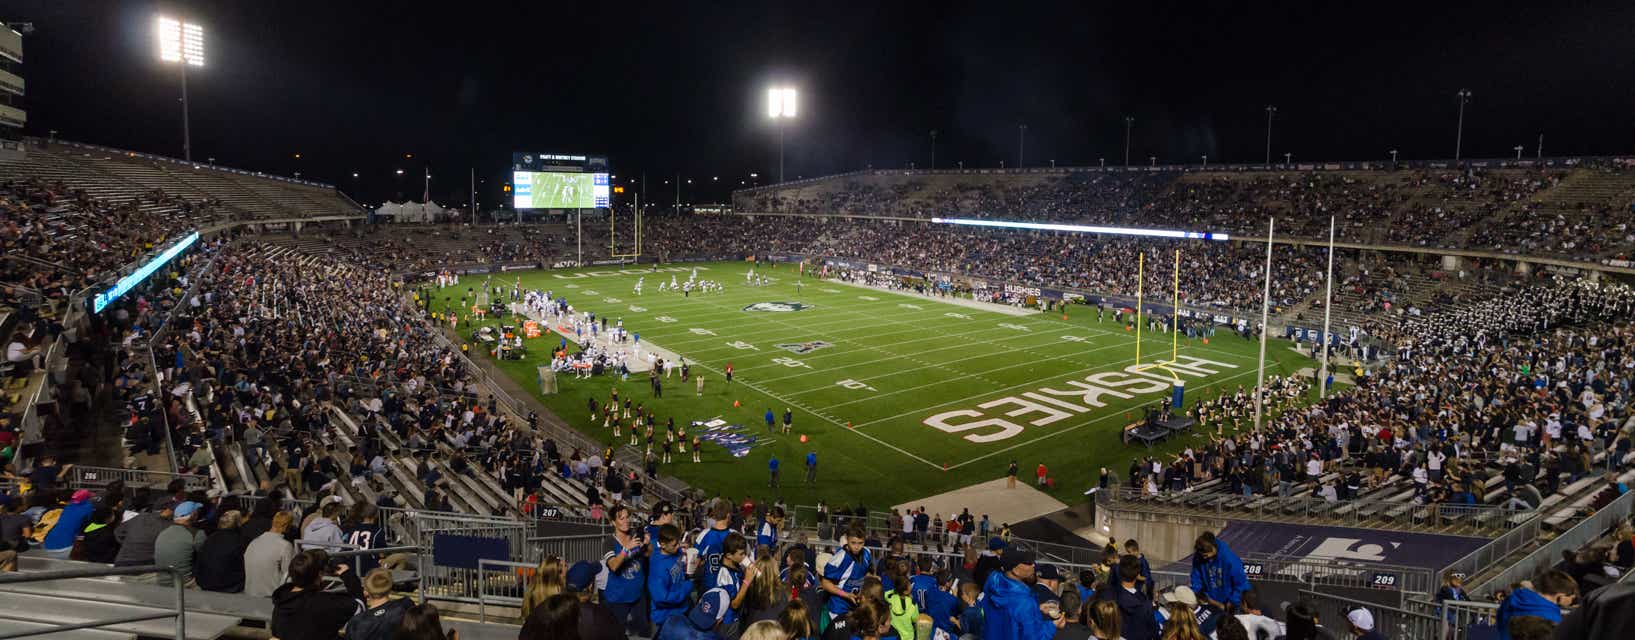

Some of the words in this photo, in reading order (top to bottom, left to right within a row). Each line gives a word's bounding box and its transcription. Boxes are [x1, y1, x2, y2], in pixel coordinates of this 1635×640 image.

[1004, 284, 1041, 297] HUSKIES
[923, 355, 1239, 443] HUSKIES
[542, 508, 557, 518] 207
[348, 530, 371, 552] 43
[1243, 564, 1262, 575] 208
[1374, 575, 1395, 585] 209
